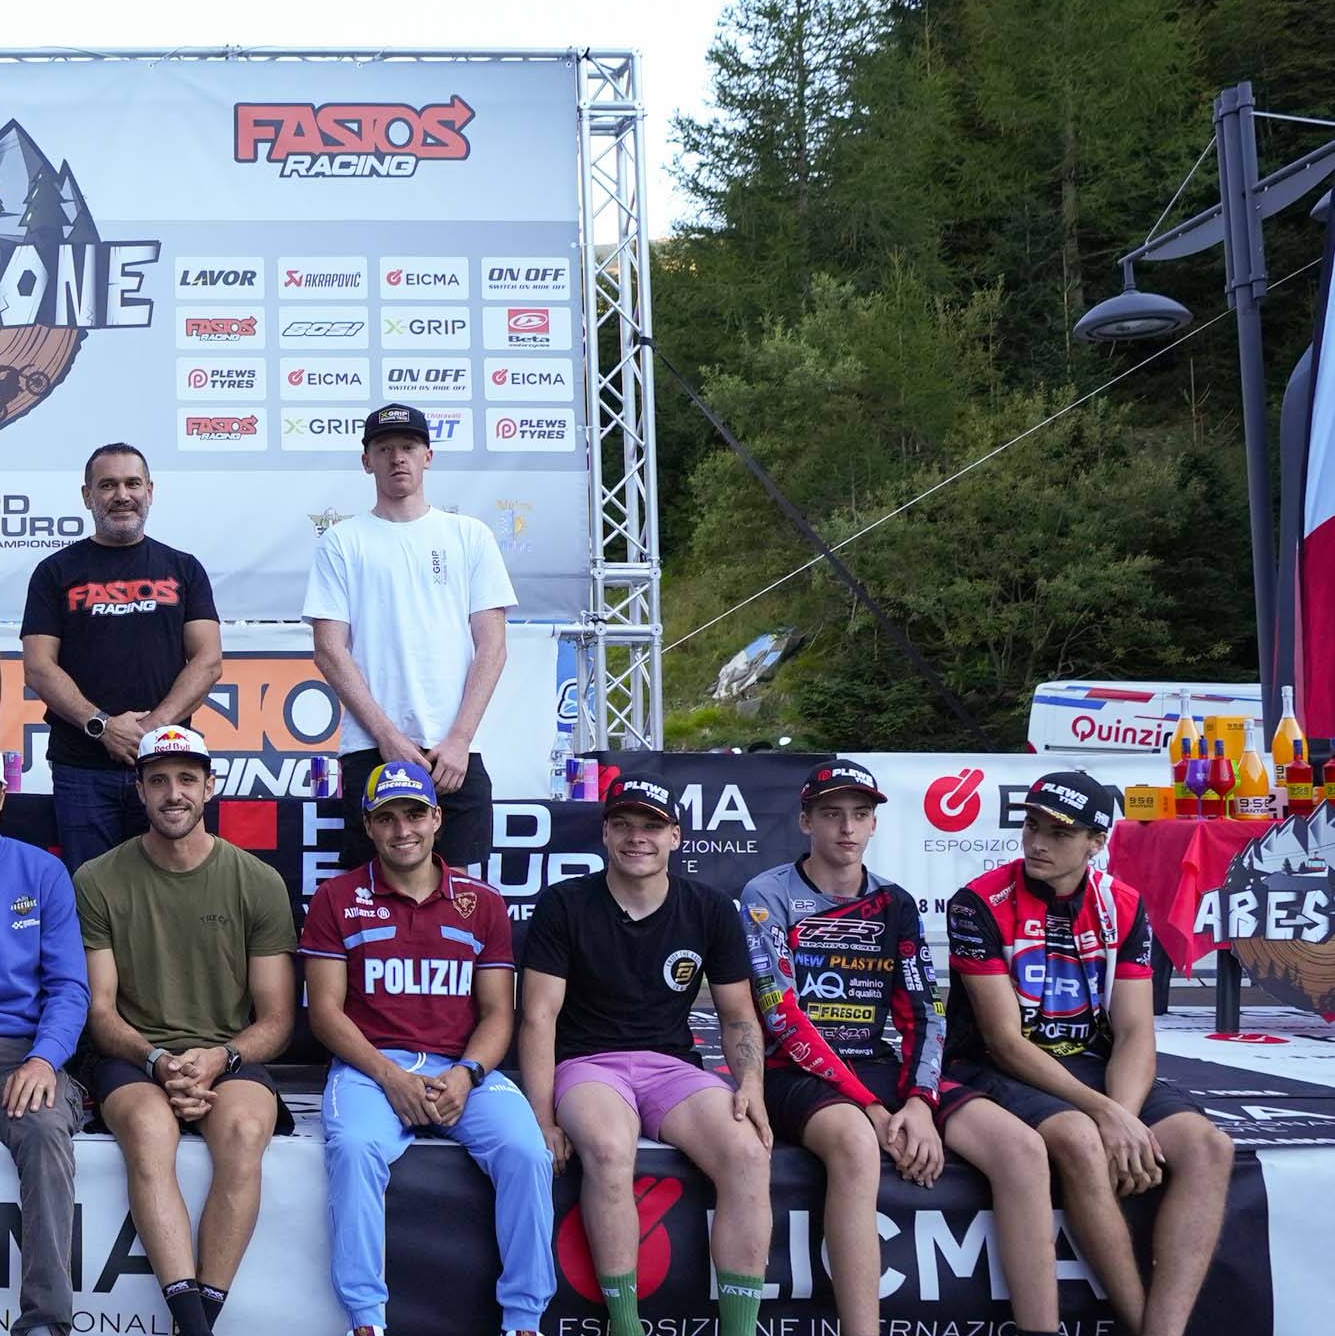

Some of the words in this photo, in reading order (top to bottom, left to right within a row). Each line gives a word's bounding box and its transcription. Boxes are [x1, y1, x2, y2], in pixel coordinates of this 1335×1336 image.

[234, 94, 476, 164] FASTOS
[278, 153, 420, 178] RACING
[179, 270, 257, 287] LAVOR
[405, 273, 460, 286] EICMA
[488, 267, 521, 282] ON
[524, 267, 566, 282] OFF
[383, 319, 467, 335] X-GRIP
[199, 333, 240, 341] RACING
[508, 335, 550, 343] Beta
[210, 369, 256, 378] PLEWS
[307, 372, 362, 385] EICMA
[388, 368, 421, 383] ON
[424, 368, 466, 382] OFF
[511, 373, 565, 385] EICMA
[210, 379, 254, 389] TYRES
[284, 418, 365, 435] X-GRIP
[427, 420, 461, 439] HT
[519, 419, 566, 428] PLEWS
[200, 432, 241, 440] RACING
[519, 430, 565, 440] TYRES
[67, 577, 183, 612] FASTOS
[91, 599, 158, 615] RACING
[832, 768, 873, 782] PLEWS
[377, 780, 423, 793] MICHELIN
[623, 780, 669, 798] PLEWS
[1040, 782, 1089, 805] PLEWS
[924, 839, 1023, 853] ESPOSIZIO
[344, 907, 376, 919] Allianz
[795, 952, 825, 968] NEW
[829, 955, 895, 971] PLASTIC
[364, 957, 473, 996] POLIZIA
[849, 978, 884, 989] aluminio
[821, 1005, 873, 1020] FRESCO
[718, 1283, 762, 1299] VANS
